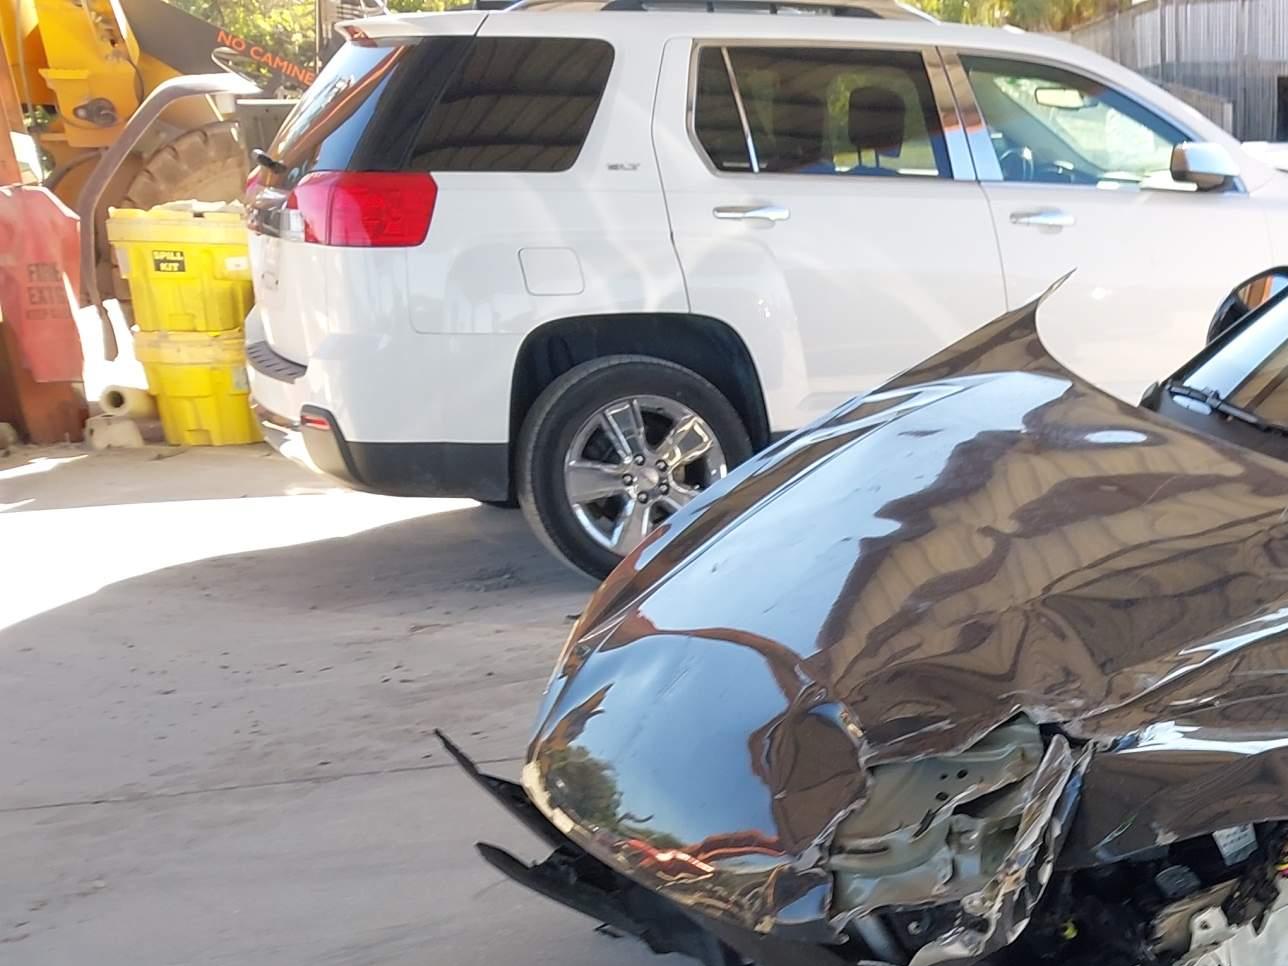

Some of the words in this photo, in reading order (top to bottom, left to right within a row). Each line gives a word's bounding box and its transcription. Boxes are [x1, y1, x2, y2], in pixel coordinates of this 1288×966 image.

[217, 30, 246, 51] NO
[250, 46, 316, 86] CAMINE
[153, 251, 184, 260] SPILL
[160, 262, 180, 271] KIT
